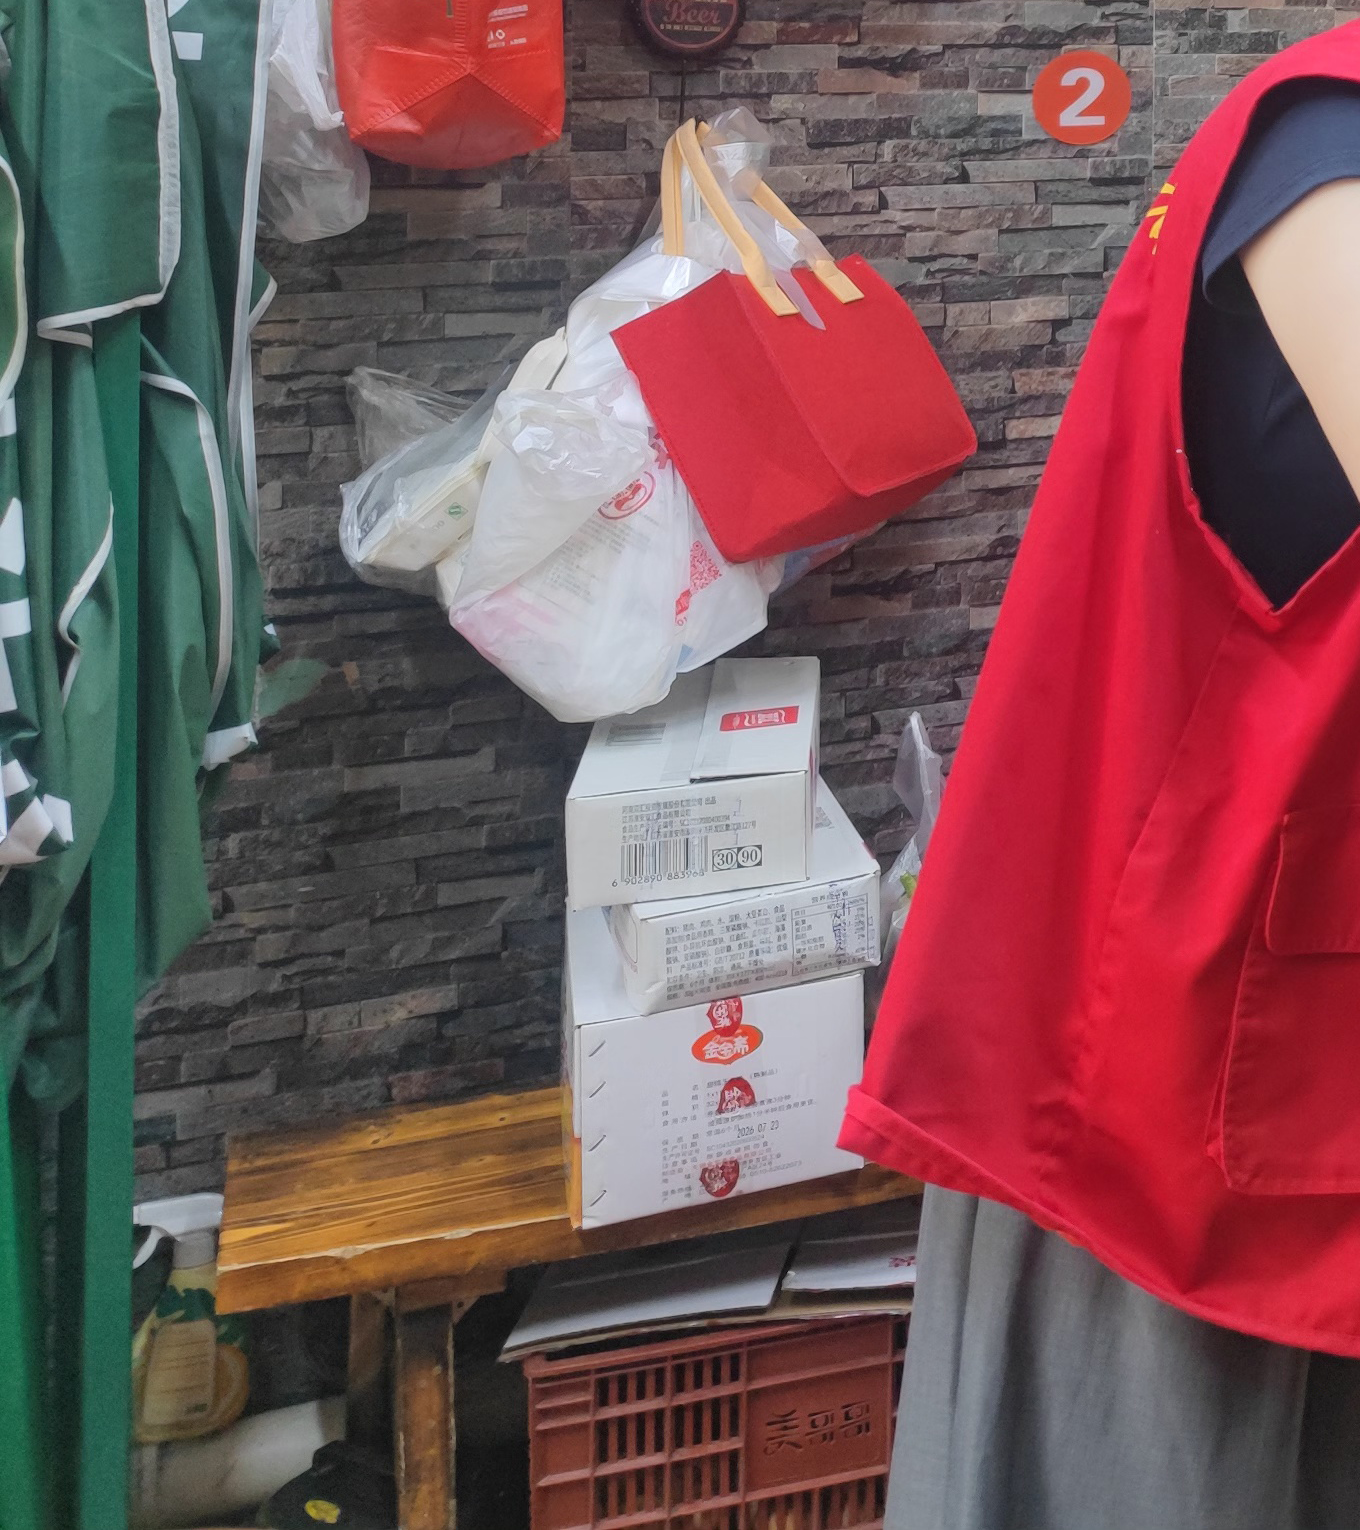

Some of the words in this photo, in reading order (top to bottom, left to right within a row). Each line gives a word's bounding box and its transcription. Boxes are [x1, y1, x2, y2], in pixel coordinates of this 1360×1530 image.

[1059, 67, 1106, 127] 2
[716, 852, 734, 867] 30
[741, 849, 758, 864] 90
